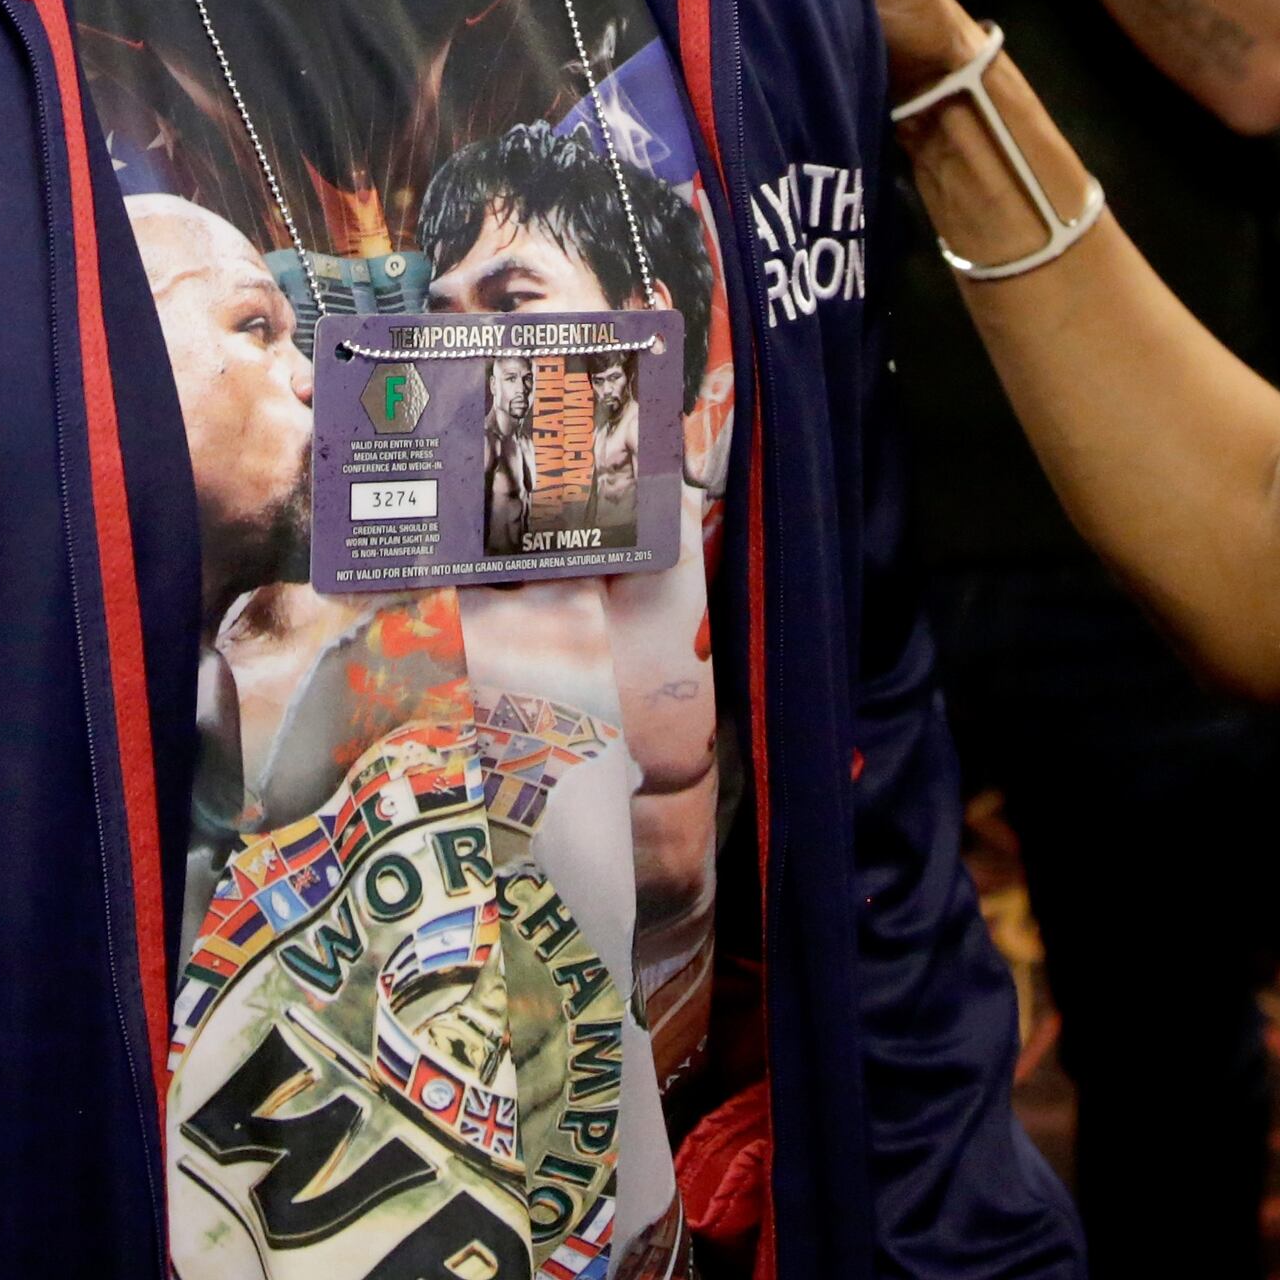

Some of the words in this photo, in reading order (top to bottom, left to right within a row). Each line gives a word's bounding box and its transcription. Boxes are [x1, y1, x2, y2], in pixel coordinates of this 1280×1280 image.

[388, 324, 506, 350] TEMPORARY
[510, 322, 620, 348] CREDENTIAL
[385, 375, 407, 420] F
[350, 440, 373, 450] VALID
[374, 439, 389, 450] FOR
[389, 439, 413, 449] ENTRY
[415, 438, 424, 448] TO
[425, 438, 440, 448] THE
[531, 355, 565, 518] AYWEATHE
[353, 452, 378, 461] MEDIA
[410, 449, 434, 459] PRESS
[342, 463, 390, 474] CONFERENCE
[391, 462, 408, 472] AND
[372, 490, 417, 508] 3274
[352, 524, 398, 535] CREDENTIAL
[399, 523, 428, 533] SHOULD
[428, 522, 439, 531] BE
[345, 537, 369, 547] WORN
[369, 536, 378, 546] IN
[378, 536, 401, 546] PLAIN
[401, 534, 424, 544] SIGHT
[424, 533, 440, 543] AND
[521, 530, 554, 552] SAT
[351, 549, 359, 559] IS
[360, 545, 434, 558] NON-TRANSFERABLE
[336, 569, 354, 582] NOT
[355, 568, 381, 581] VALID
[383, 567, 400, 578] FOR
[401, 566, 430, 578] ENTRY
[431, 564, 450, 576] INTO
[452, 563, 473, 574] MGM
[475, 561, 504, 573] GRAND
[505, 557, 537, 571] GARDEN
[538, 556, 566, 568] ARENA
[566, 553, 607, 567] SATURDAY,
[608, 552, 624, 565] MAY
[634, 550, 653, 561] 2015
